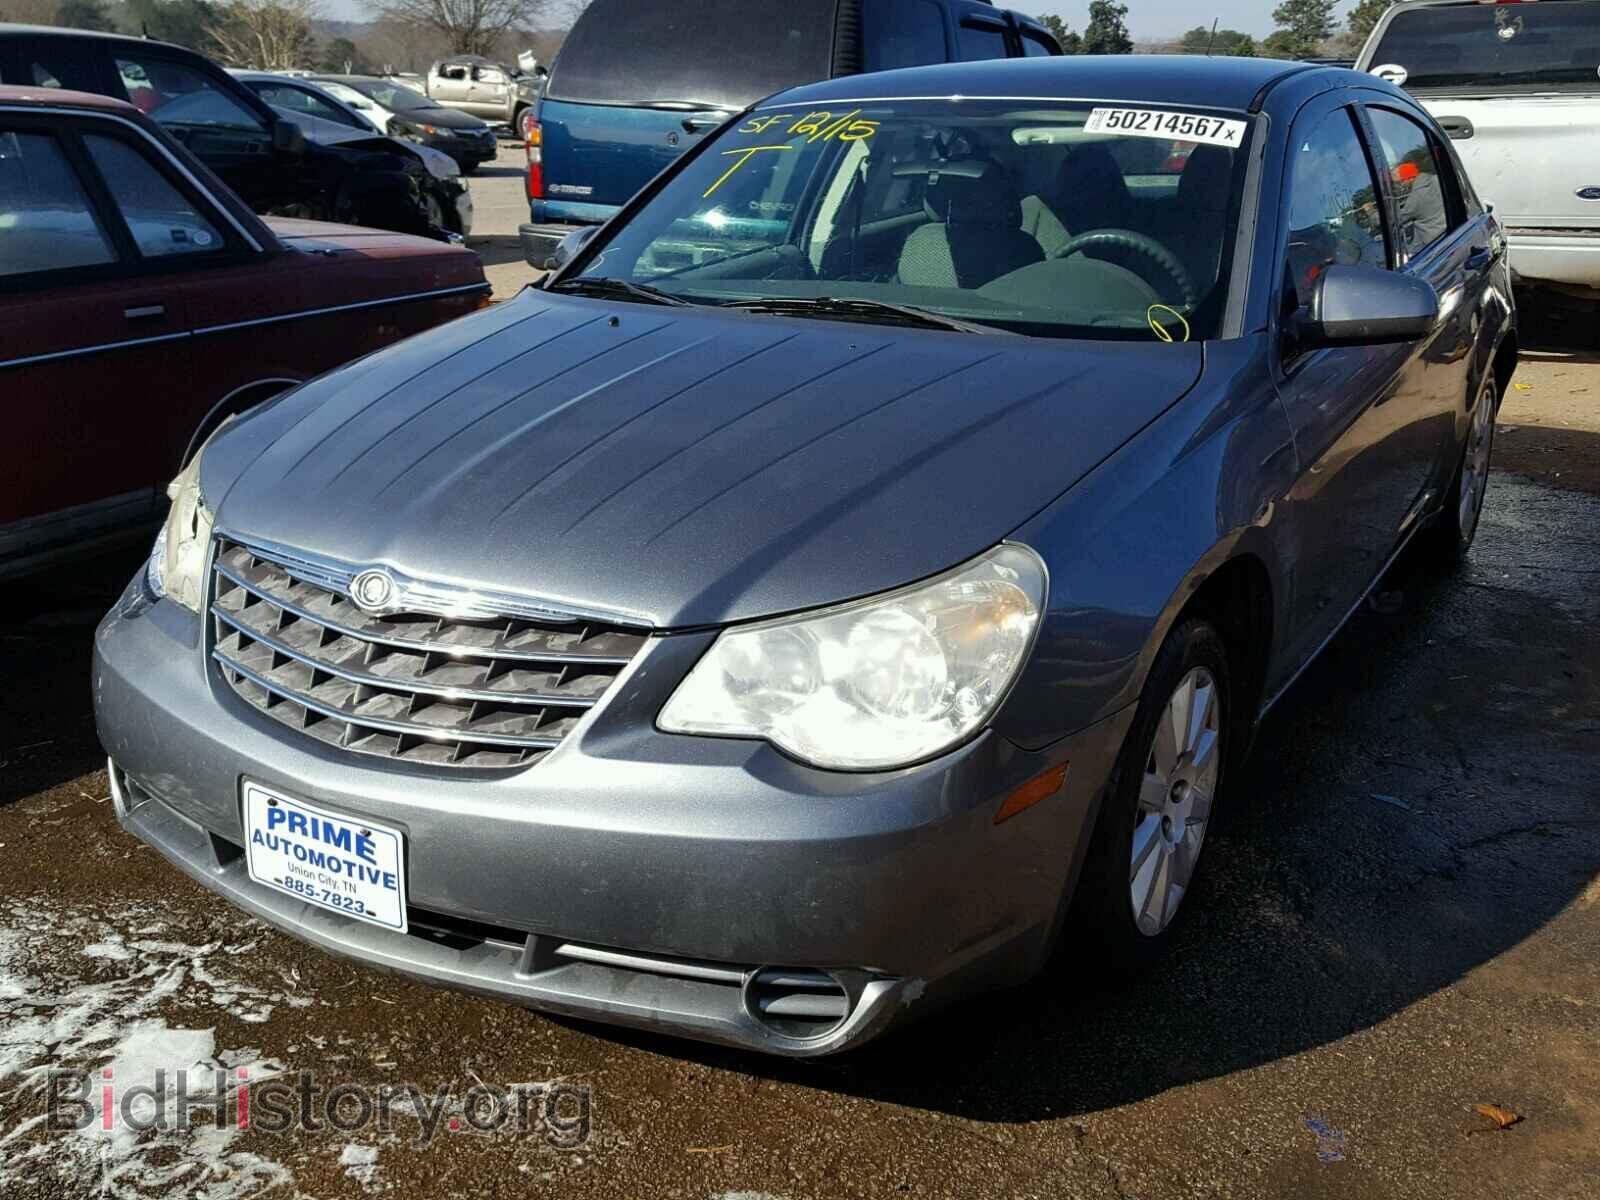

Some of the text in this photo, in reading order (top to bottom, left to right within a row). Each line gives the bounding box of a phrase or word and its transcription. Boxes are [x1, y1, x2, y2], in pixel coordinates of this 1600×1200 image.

[1106, 110, 1226, 139] 50214567
[267, 807, 377, 866] PRIME
[252, 828, 397, 891] AUTOMOTIVE
[287, 861, 316, 879] Union
[342, 881, 357, 894] TN
[284, 876, 365, 914] 885-7823
